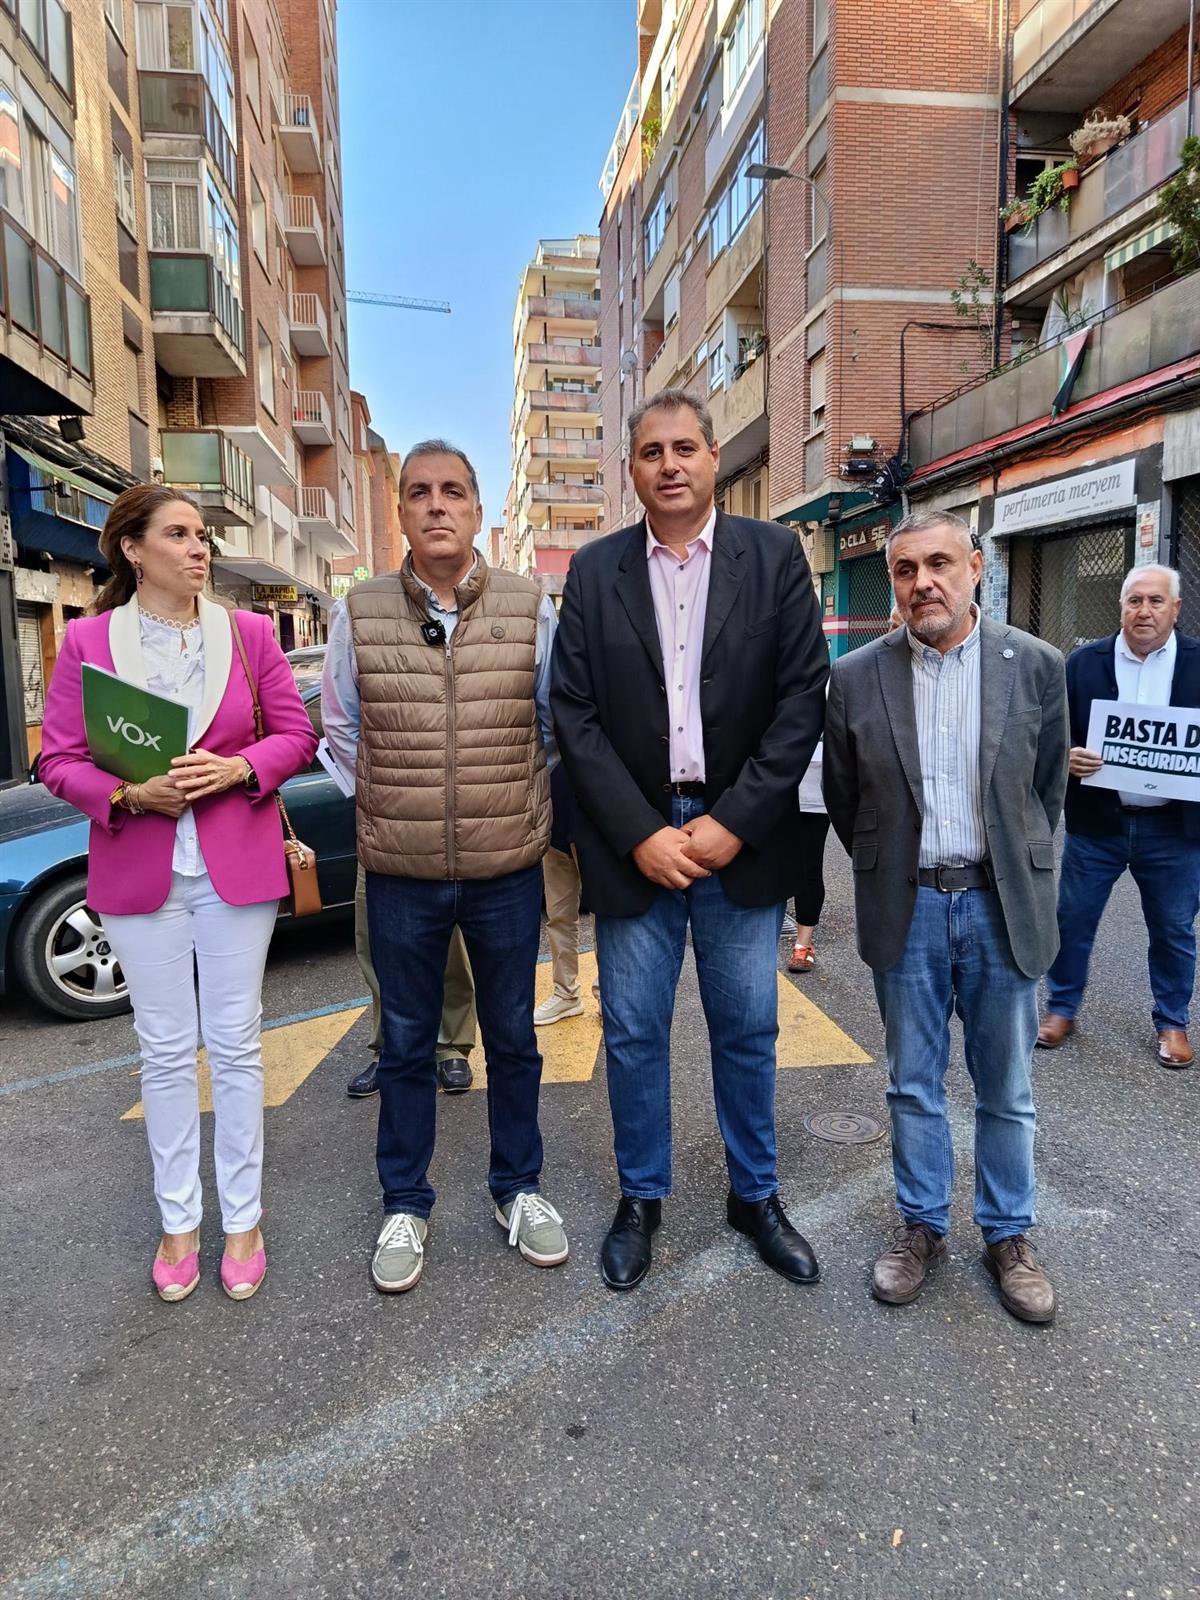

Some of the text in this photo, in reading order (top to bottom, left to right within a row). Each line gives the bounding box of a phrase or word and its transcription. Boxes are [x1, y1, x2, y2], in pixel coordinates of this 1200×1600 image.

[1068, 473, 1121, 499] meryem
[106, 715, 162, 752] VOX
[1105, 714, 1177, 747] BASTA
[1103, 744, 1200, 774] INSEGURIDA
